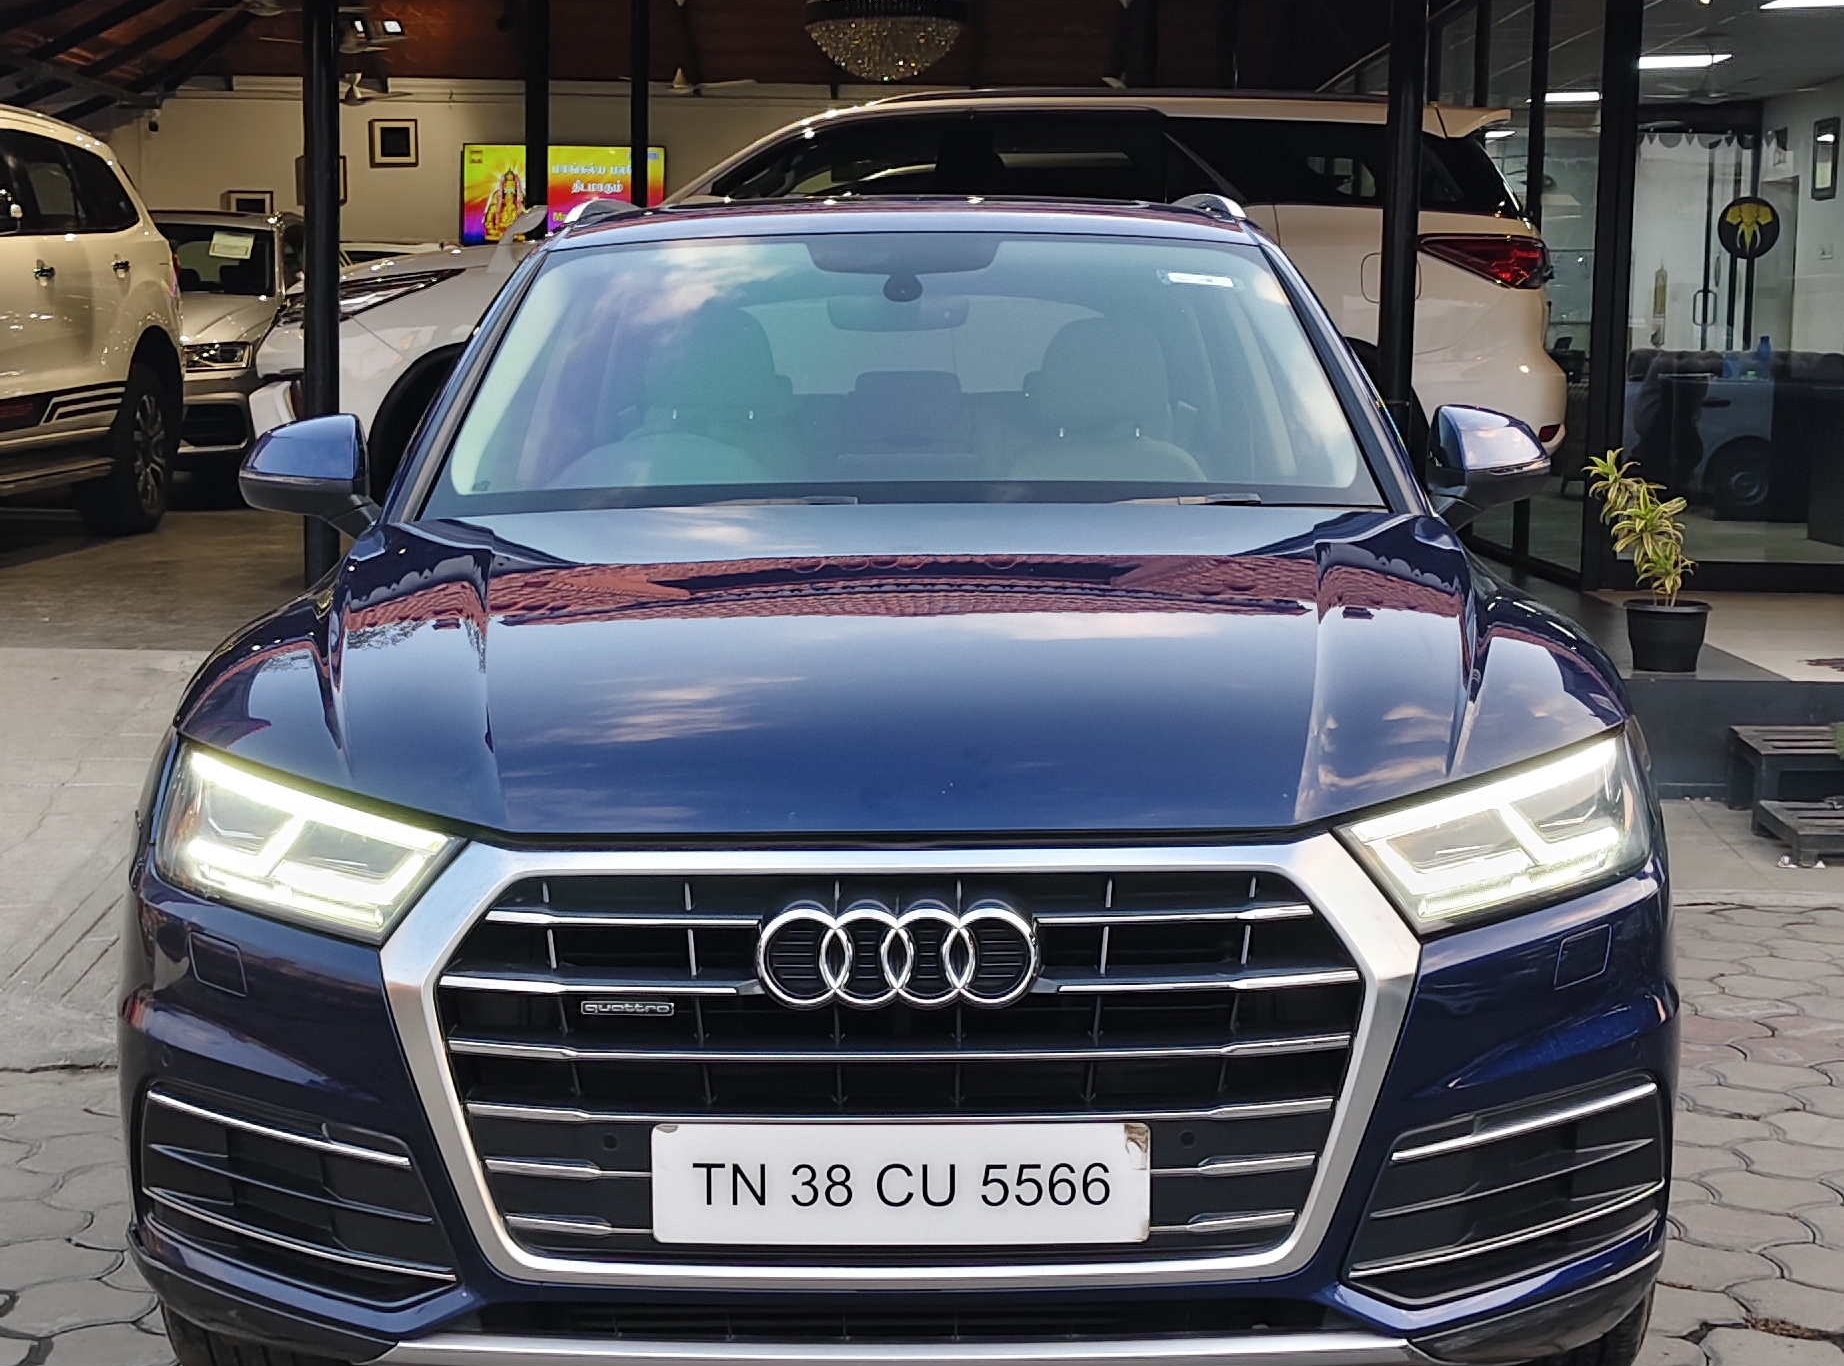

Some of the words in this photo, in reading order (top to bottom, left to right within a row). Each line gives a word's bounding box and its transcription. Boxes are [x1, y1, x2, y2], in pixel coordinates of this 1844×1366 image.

[571, 180, 624, 194] திடமாகும்
[584, 1003, 670, 1014] quattro
[692, 1162, 766, 1206] TN
[791, 1163, 853, 1207] 38
[876, 1163, 956, 1208] CU
[981, 1162, 1111, 1207] 5566
